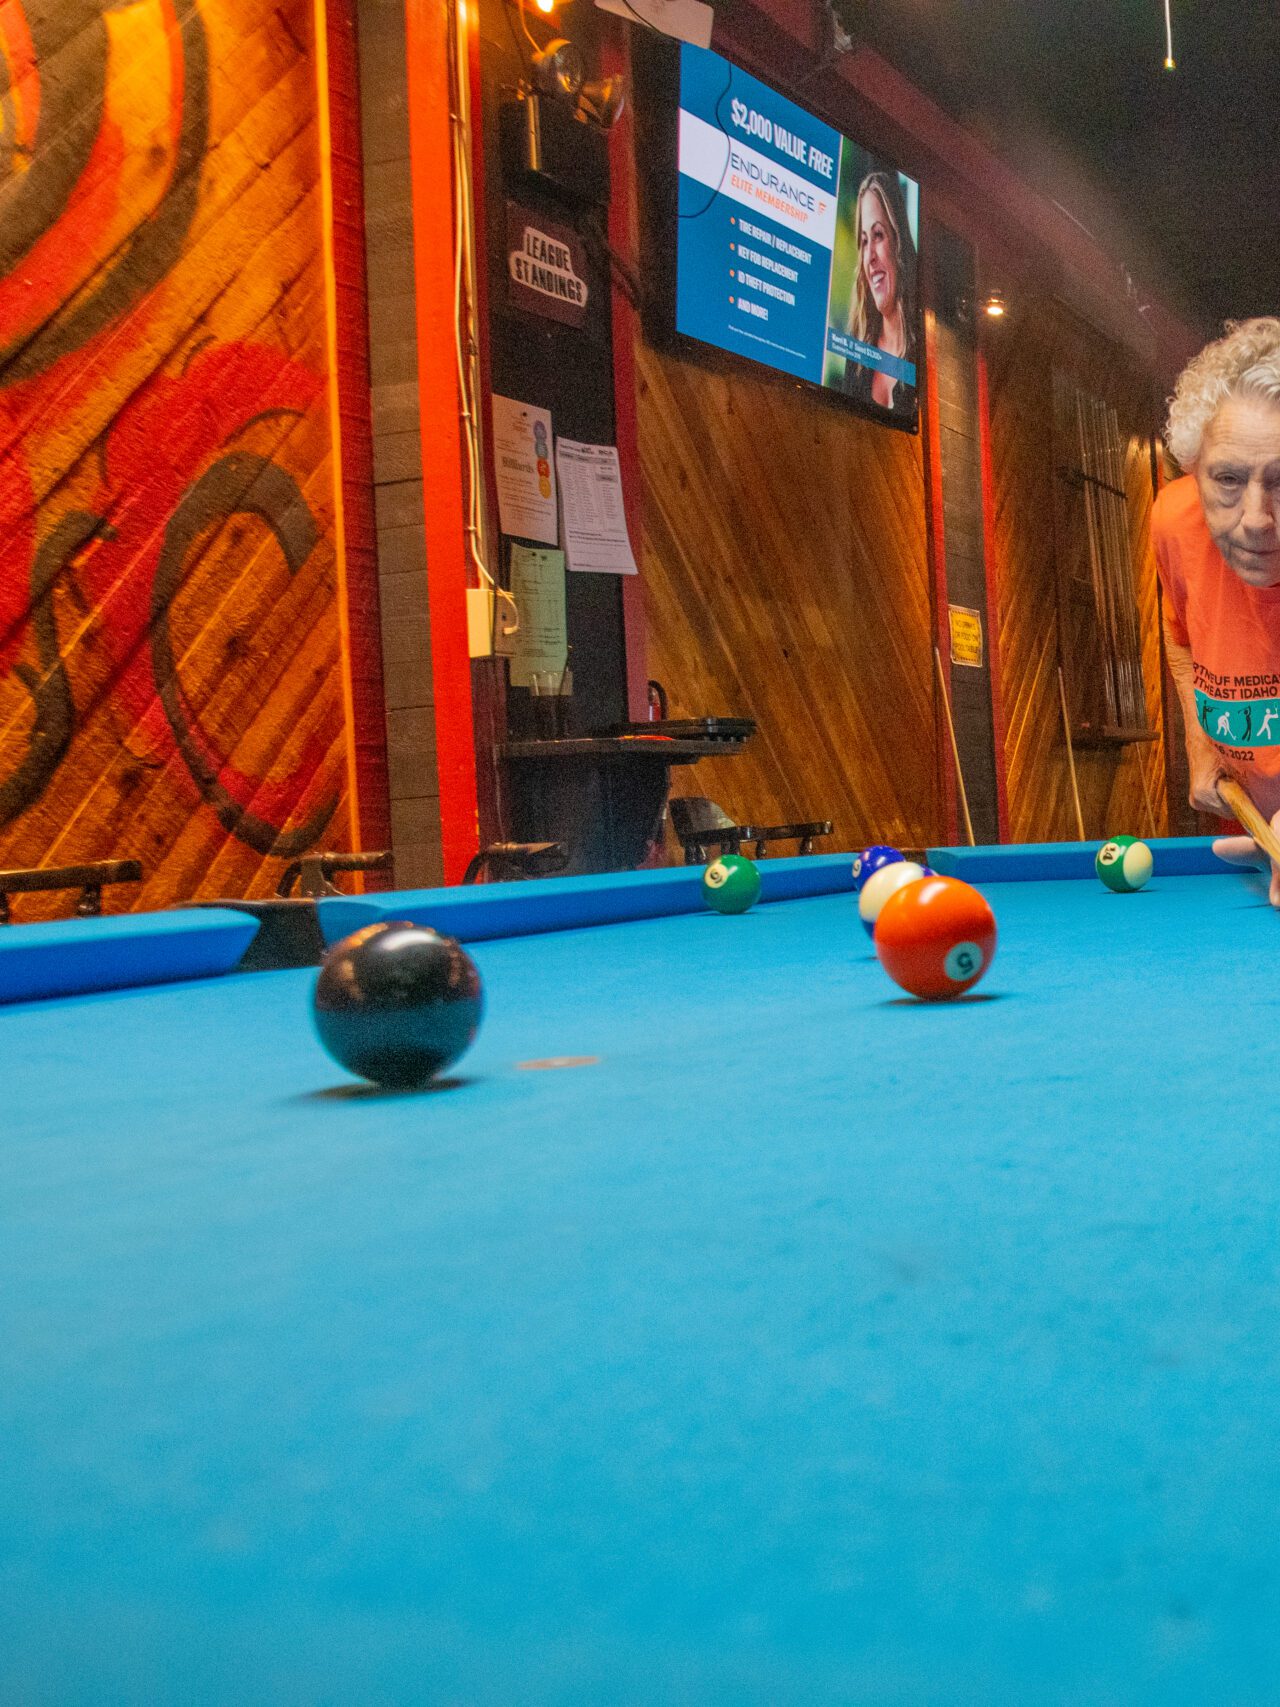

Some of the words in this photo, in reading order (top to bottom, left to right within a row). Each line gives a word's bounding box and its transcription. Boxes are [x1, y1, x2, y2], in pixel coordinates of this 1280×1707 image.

[731, 98, 773, 144] $2,000
[774, 123, 807, 165] VALUE
[808, 146, 834, 179] FREE
[731, 152, 815, 212] ENDURANCE
[731, 174, 753, 196] ELITE
[755, 188, 808, 223] MEMBERSHIP
[526, 232, 571, 272] LEAGUE
[775, 236, 812, 265] REPLACEMENT
[515, 257, 583, 304] STANDINGS
[761, 255, 799, 283] REPLACEMENT
[762, 279, 796, 307] PROTECTION
[1193, 661, 1231, 686] RTNEUF
[1240, 685, 1278, 699] IDAHO
[1229, 749, 1255, 761] 2022
